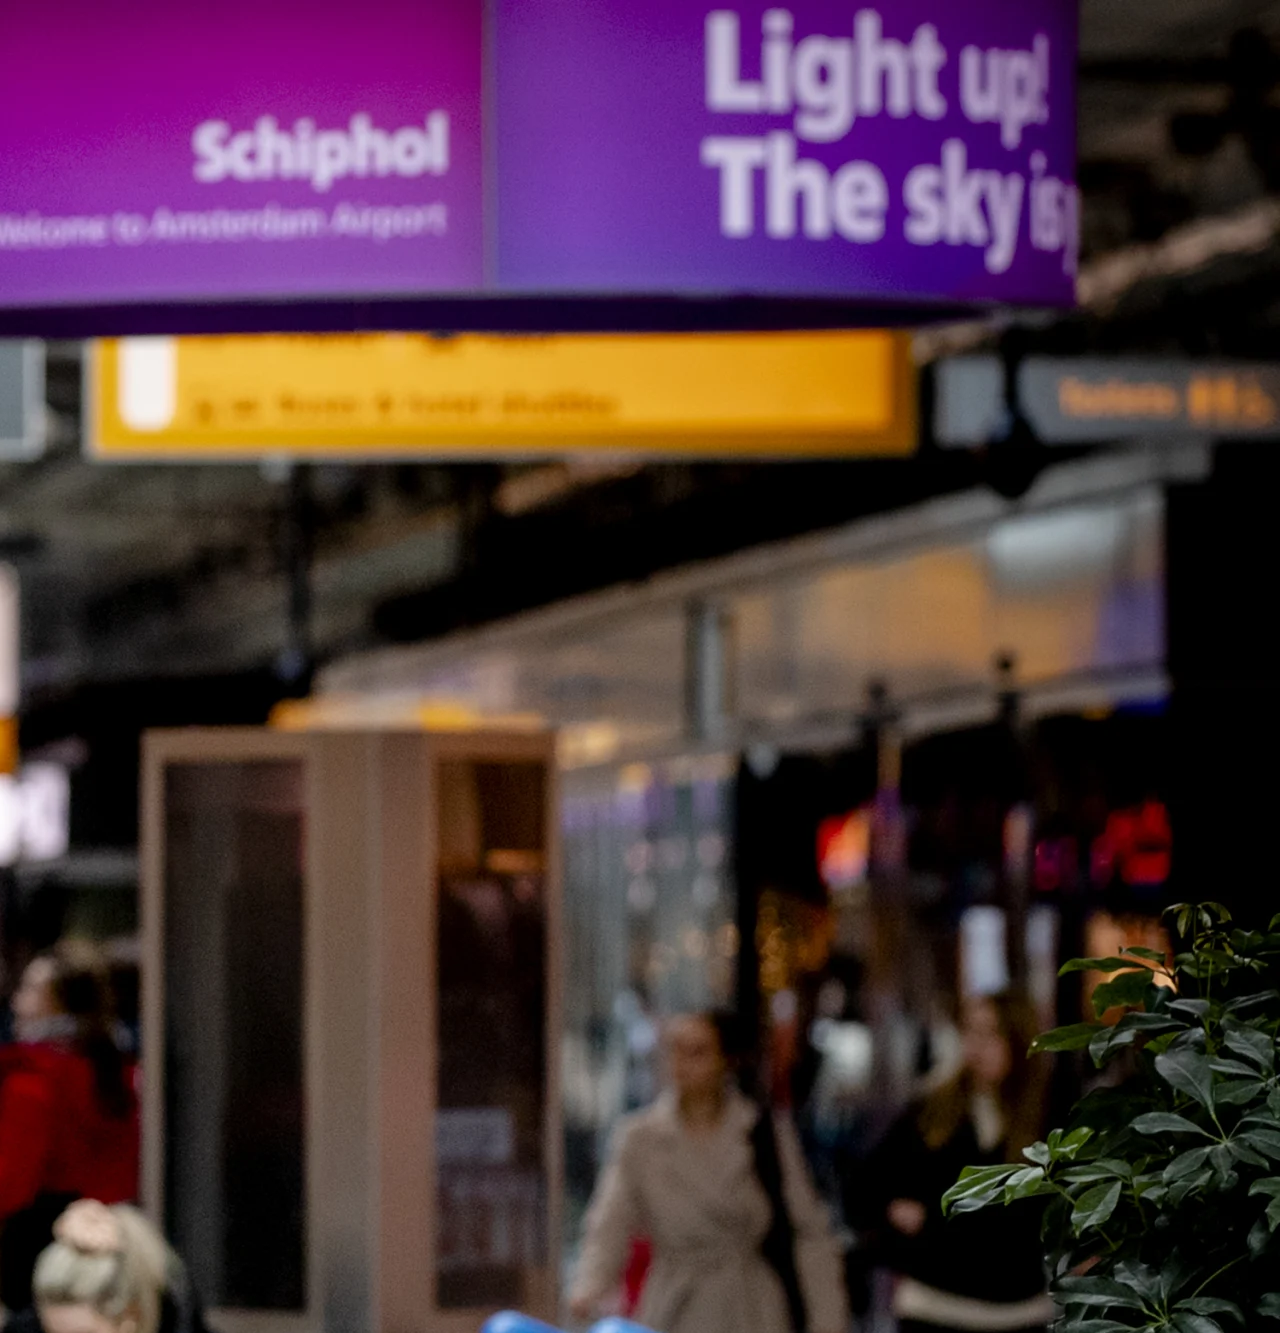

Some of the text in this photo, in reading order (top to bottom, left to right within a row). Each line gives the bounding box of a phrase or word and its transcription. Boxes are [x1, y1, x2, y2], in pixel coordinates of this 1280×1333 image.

[704, 8, 1050, 149] Light up!
[192, 110, 449, 190] Schiphol
[700, 131, 888, 242] The
[902, 138, 1023, 274] sky
[112, 211, 146, 244] to
[150, 203, 328, 243] Amsterdam
[332, 200, 448, 242] Airport
